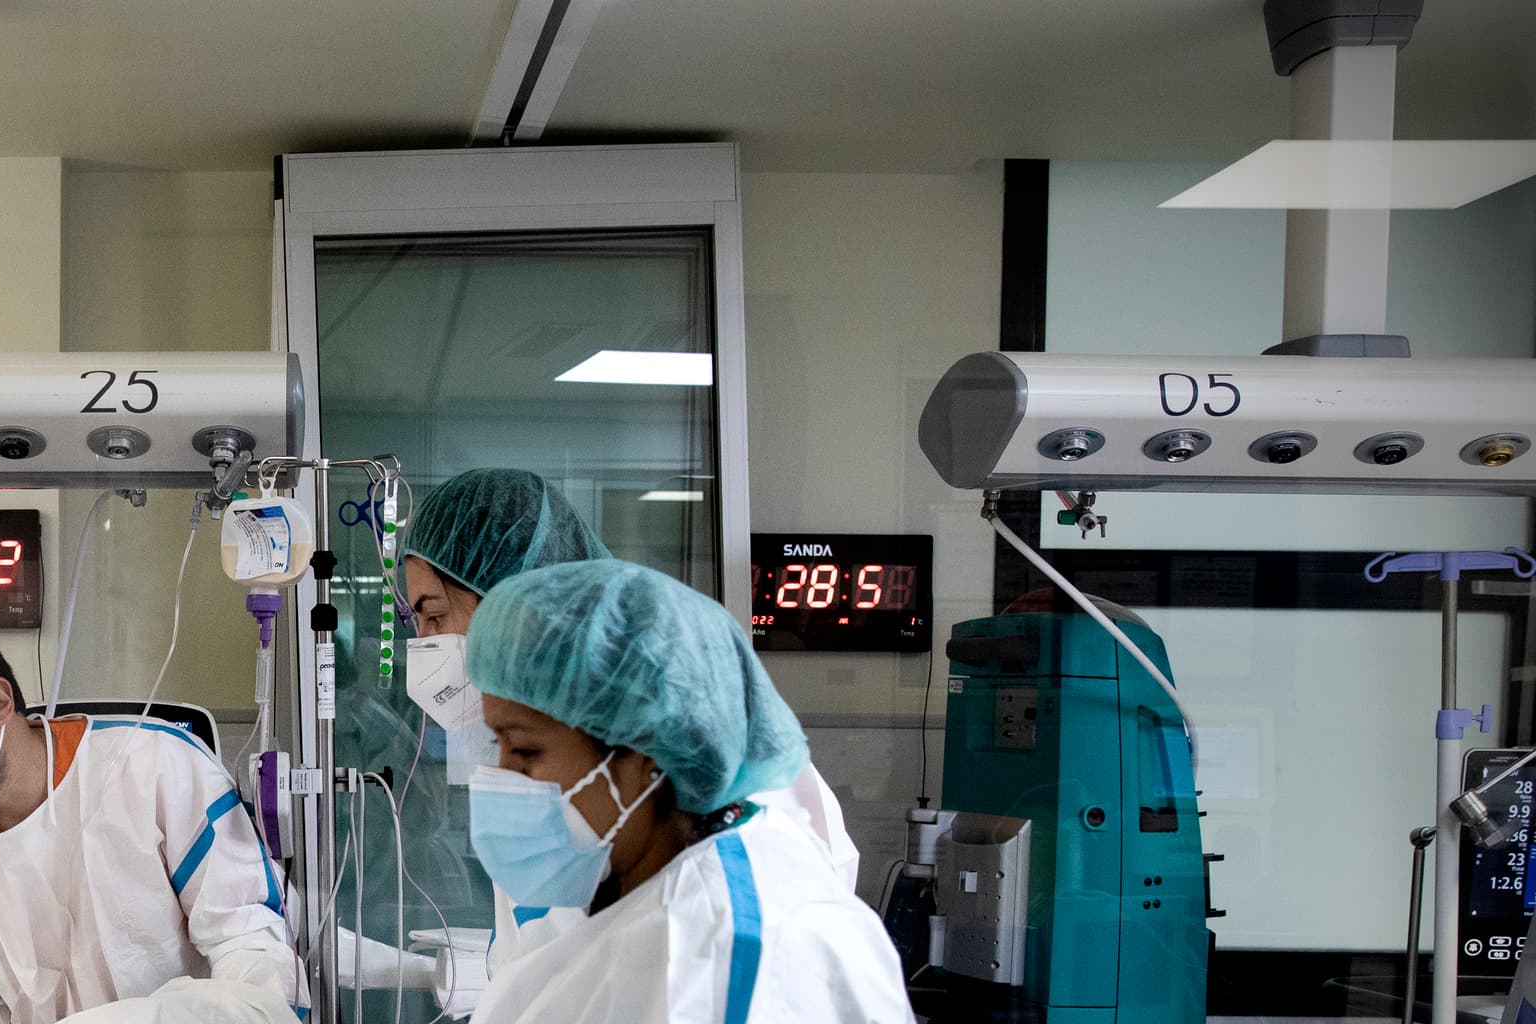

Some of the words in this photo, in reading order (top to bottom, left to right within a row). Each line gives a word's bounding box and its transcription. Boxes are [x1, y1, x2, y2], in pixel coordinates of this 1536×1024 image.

[79, 370, 159, 414] 25
[1158, 372, 1242, 418] D5
[783, 544, 833, 557] SANDA
[1514, 781, 1534, 794] 28
[1508, 805, 1531, 818] 9.9
[1507, 852, 1525, 866] 23
[1490, 876, 1523, 890] 1:2.6
